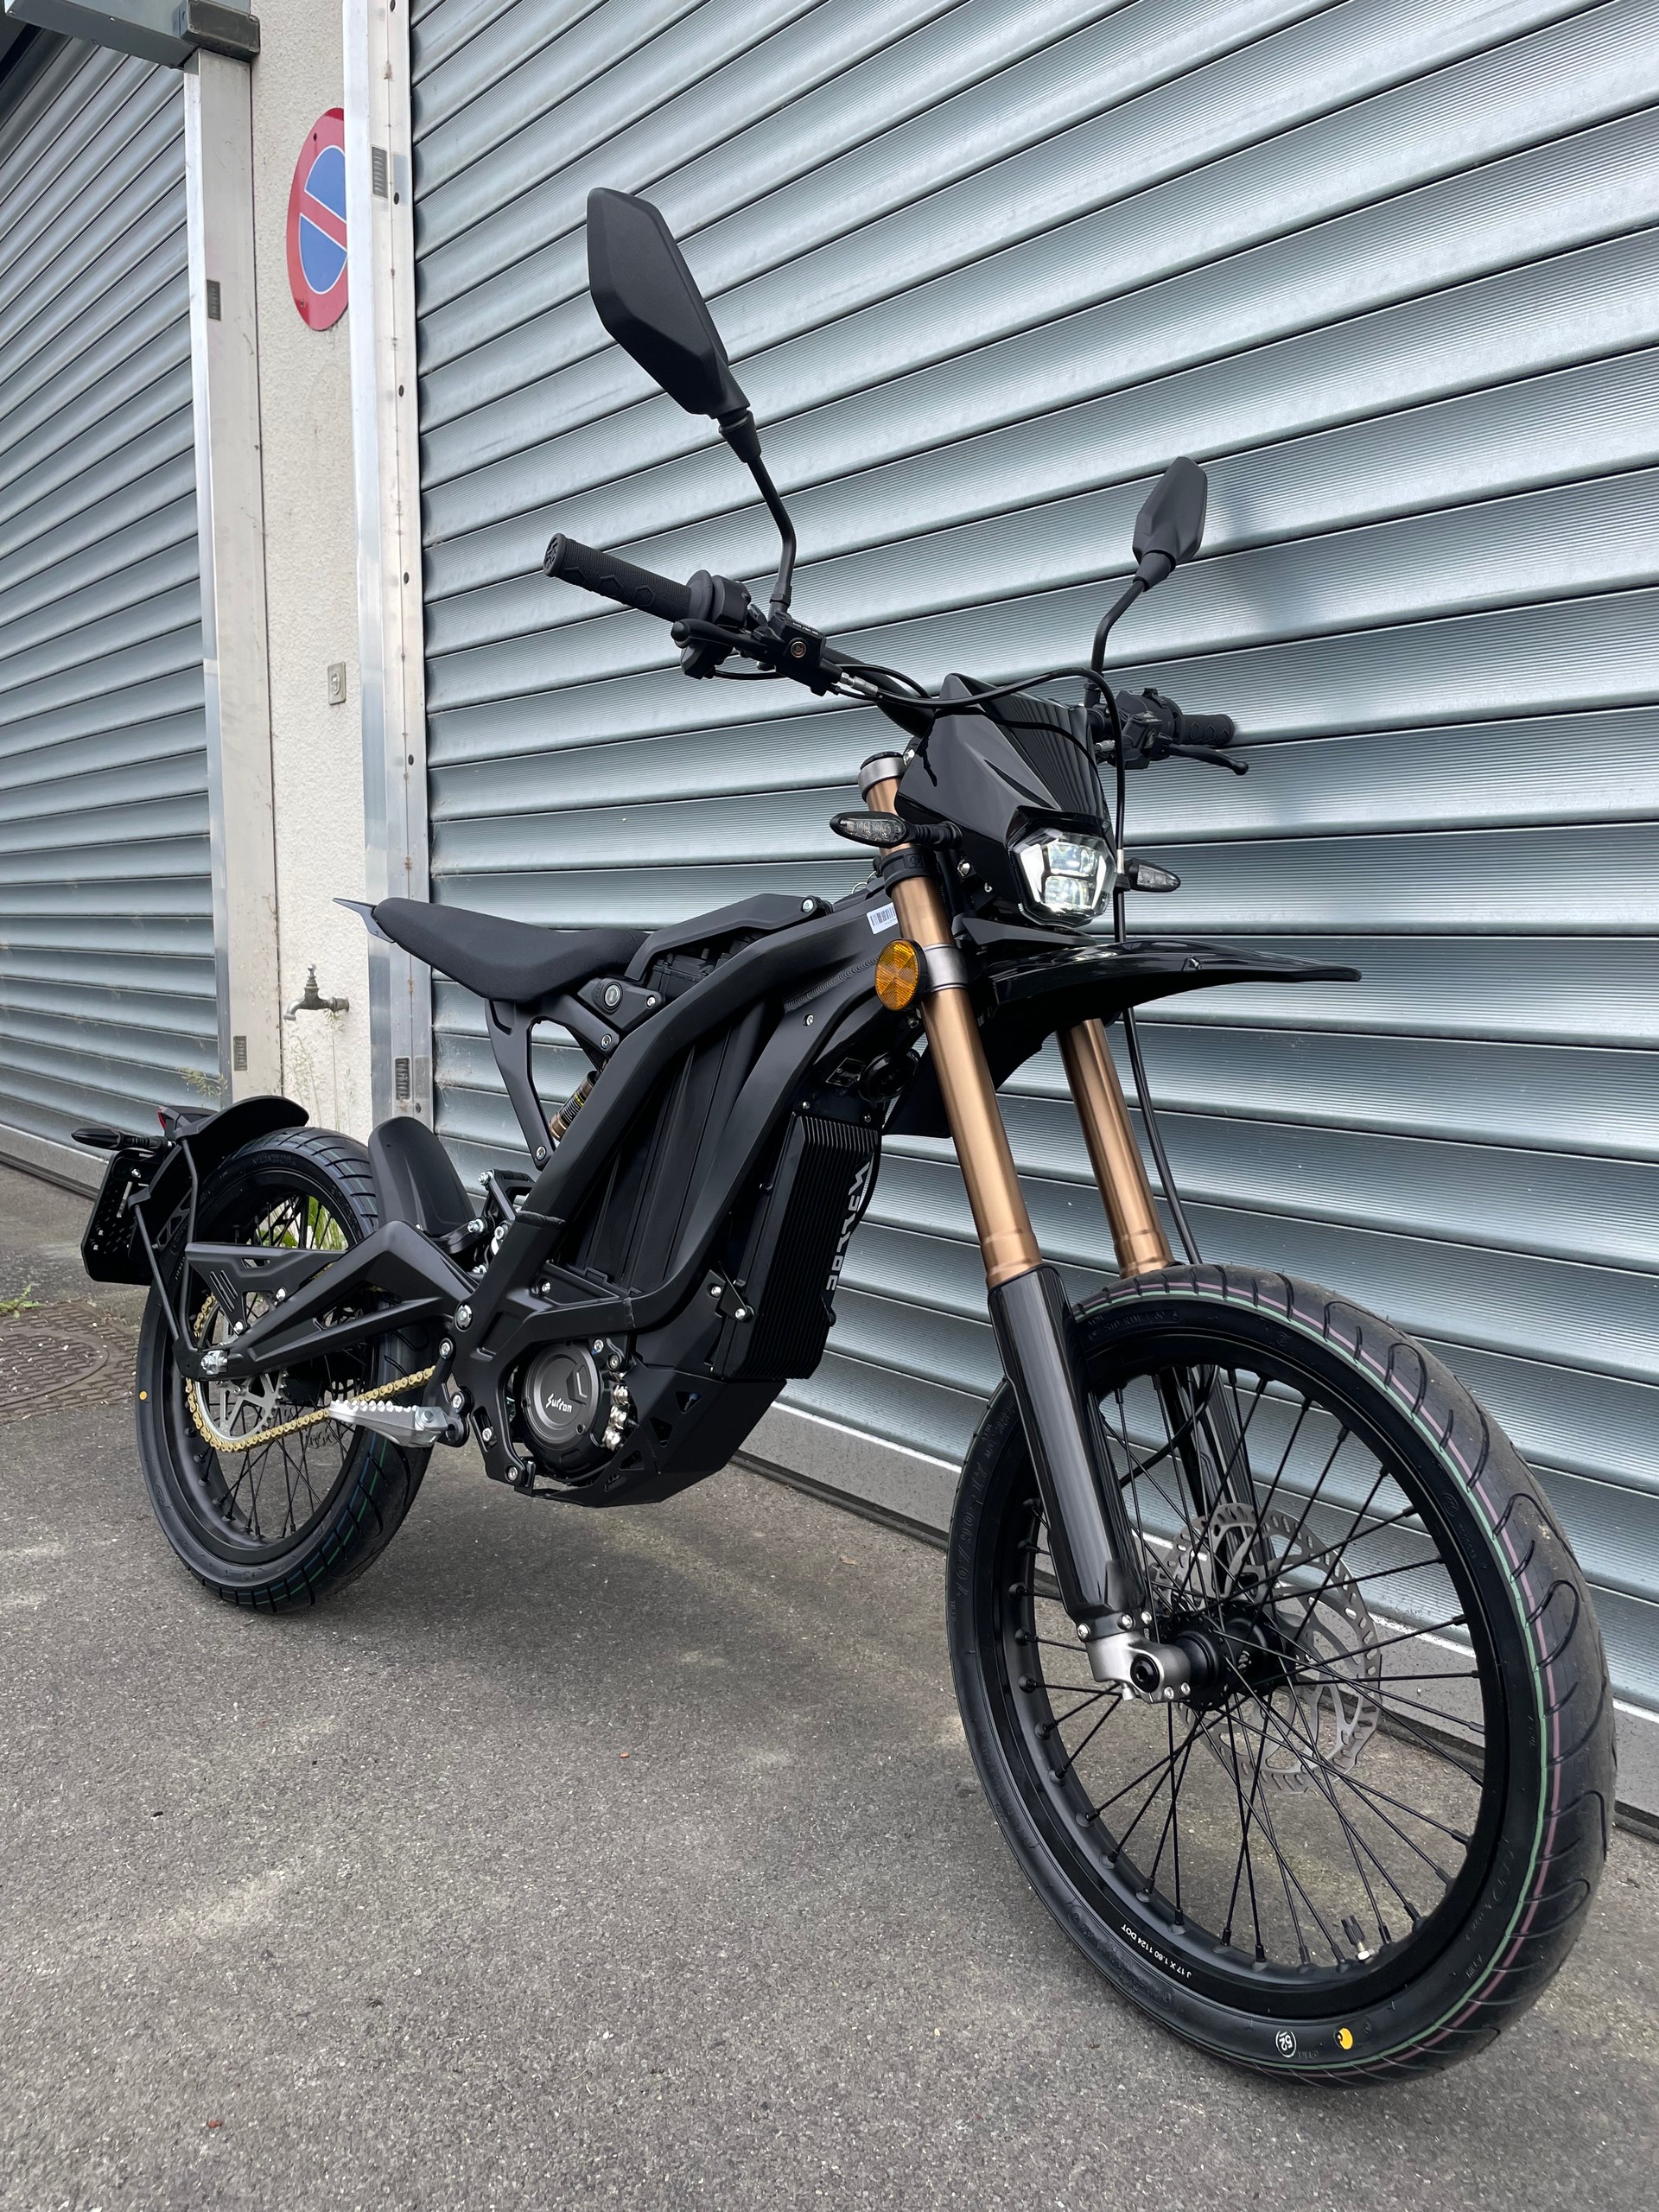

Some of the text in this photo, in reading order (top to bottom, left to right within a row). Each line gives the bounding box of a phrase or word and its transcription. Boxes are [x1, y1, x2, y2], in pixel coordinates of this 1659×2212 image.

[1121, 1923, 1137, 1941] DOT
[1137, 1937, 1154, 1954] 1124
[1154, 1950, 1168, 1965] 1.60
[1169, 1961, 1177, 1970] X
[1176, 1966, 1185, 1975] 17
